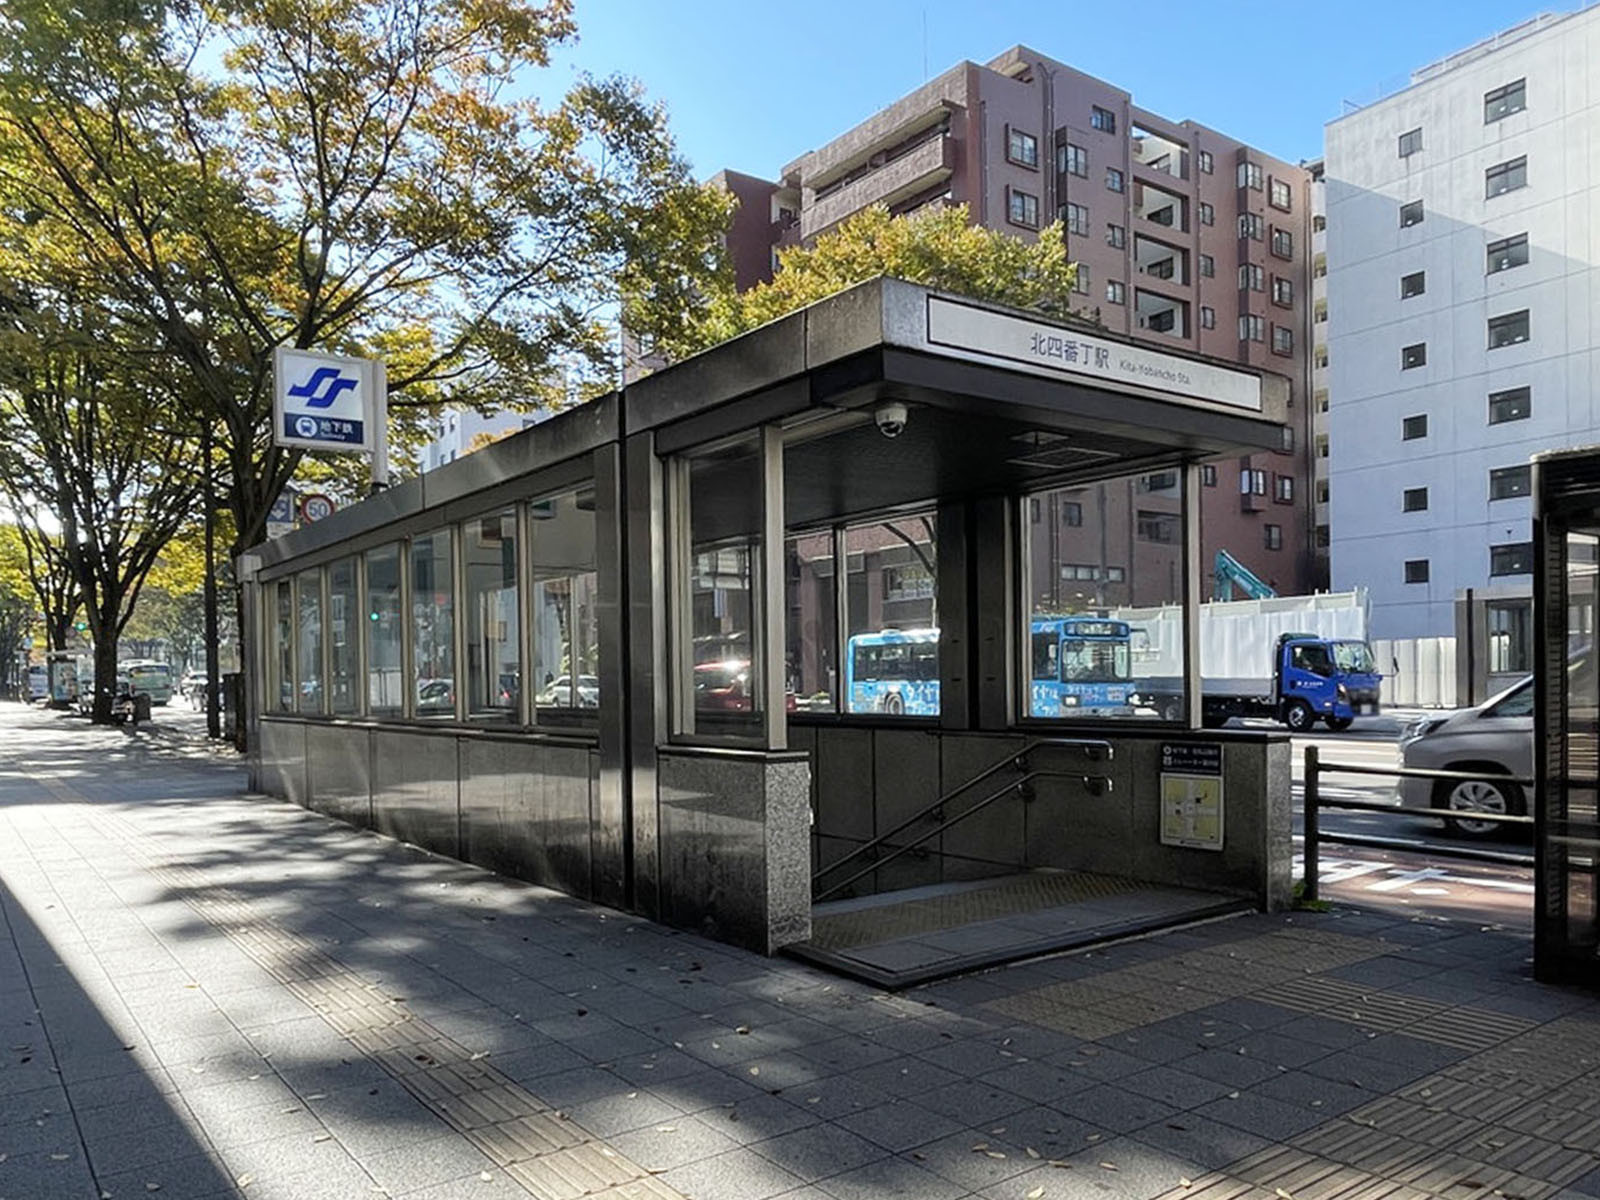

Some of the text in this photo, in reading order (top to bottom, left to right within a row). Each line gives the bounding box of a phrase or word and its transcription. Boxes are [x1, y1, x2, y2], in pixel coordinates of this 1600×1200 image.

[1030, 332, 1110, 370] 北四番丁駅
[309, 502, 327, 518] 50
